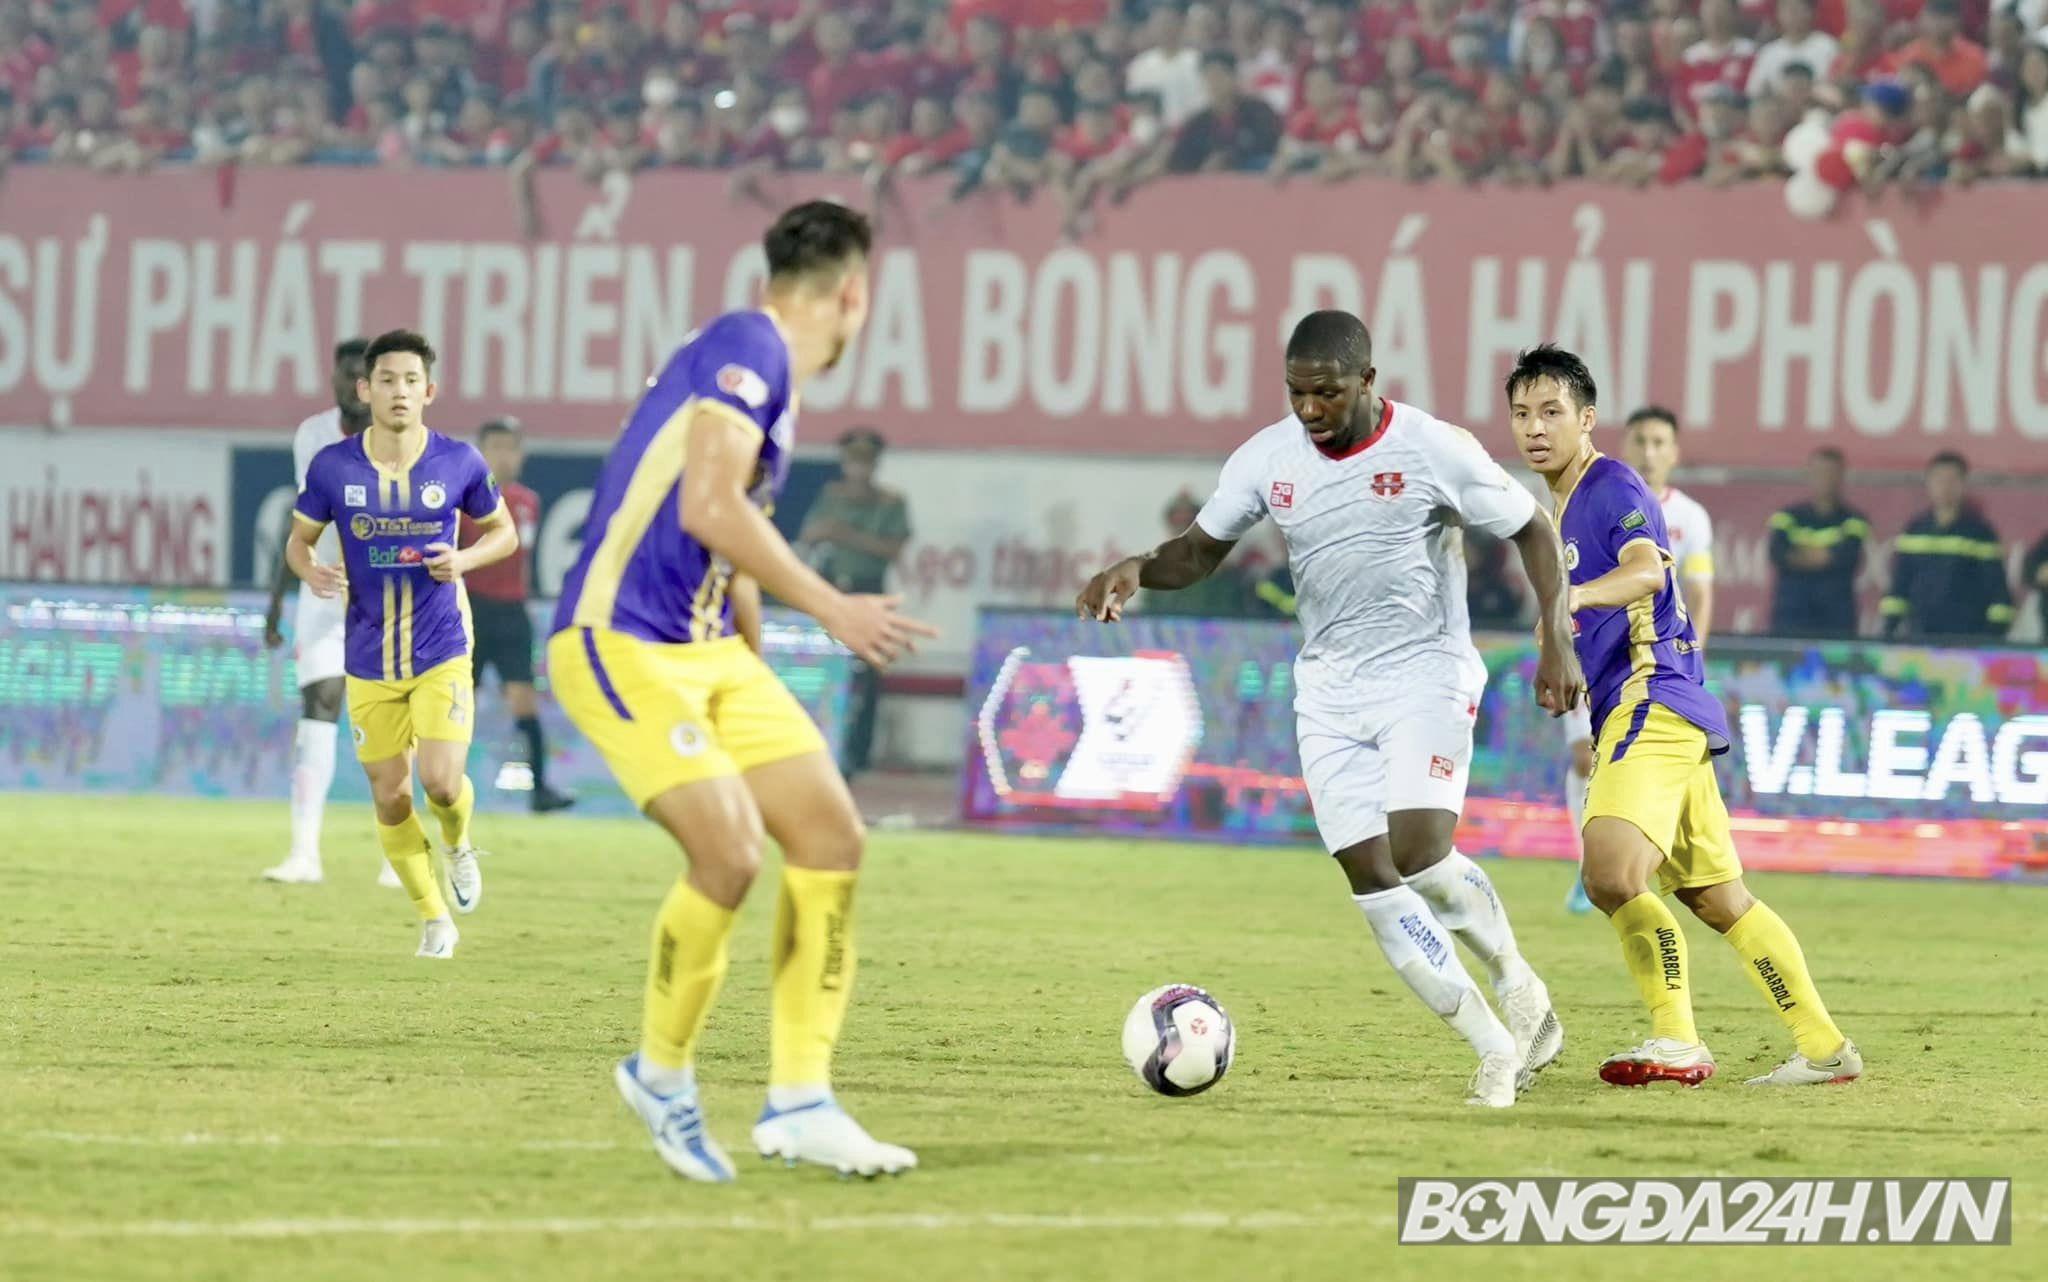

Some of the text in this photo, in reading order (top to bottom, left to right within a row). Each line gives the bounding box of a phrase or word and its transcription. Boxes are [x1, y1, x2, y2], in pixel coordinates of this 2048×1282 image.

[125, 204, 383, 395] PHÁT
[1655, 927, 1682, 991] JOGARBOLA
[1753, 956, 1797, 1013] JOGARBOLA
